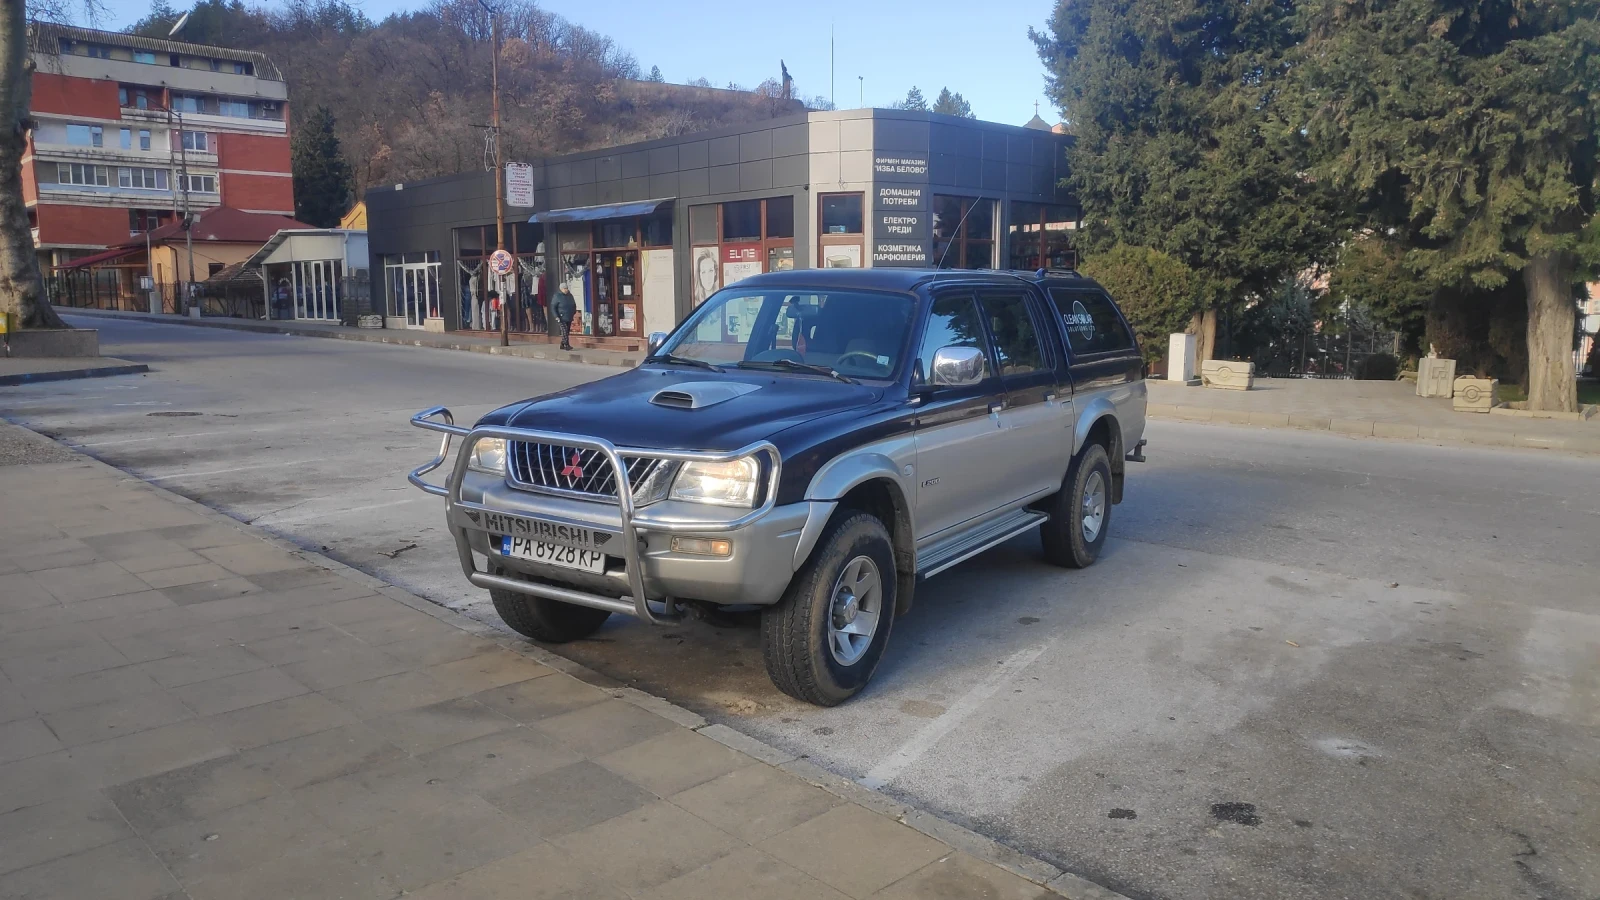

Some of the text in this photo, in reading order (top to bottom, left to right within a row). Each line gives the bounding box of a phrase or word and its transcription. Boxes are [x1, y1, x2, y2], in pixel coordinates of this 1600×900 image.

[875, 157, 926, 166] ФИРМЕН МАГАЗИН
[879, 188, 921, 197] ДОМАШНИ
[882, 197, 918, 206] ПОТРЕБИ
[883, 216, 917, 225] ЕЛЕКТРО
[887, 226, 912, 234] УРЕДИ
[878, 244, 922, 252] КОЗМЕТИКА
[873, 253, 926, 262] ПАРФЮМЕРИЯ
[484, 512, 589, 548] MITSUBISHI
[512, 536, 601, 568] PA 8928 KP
